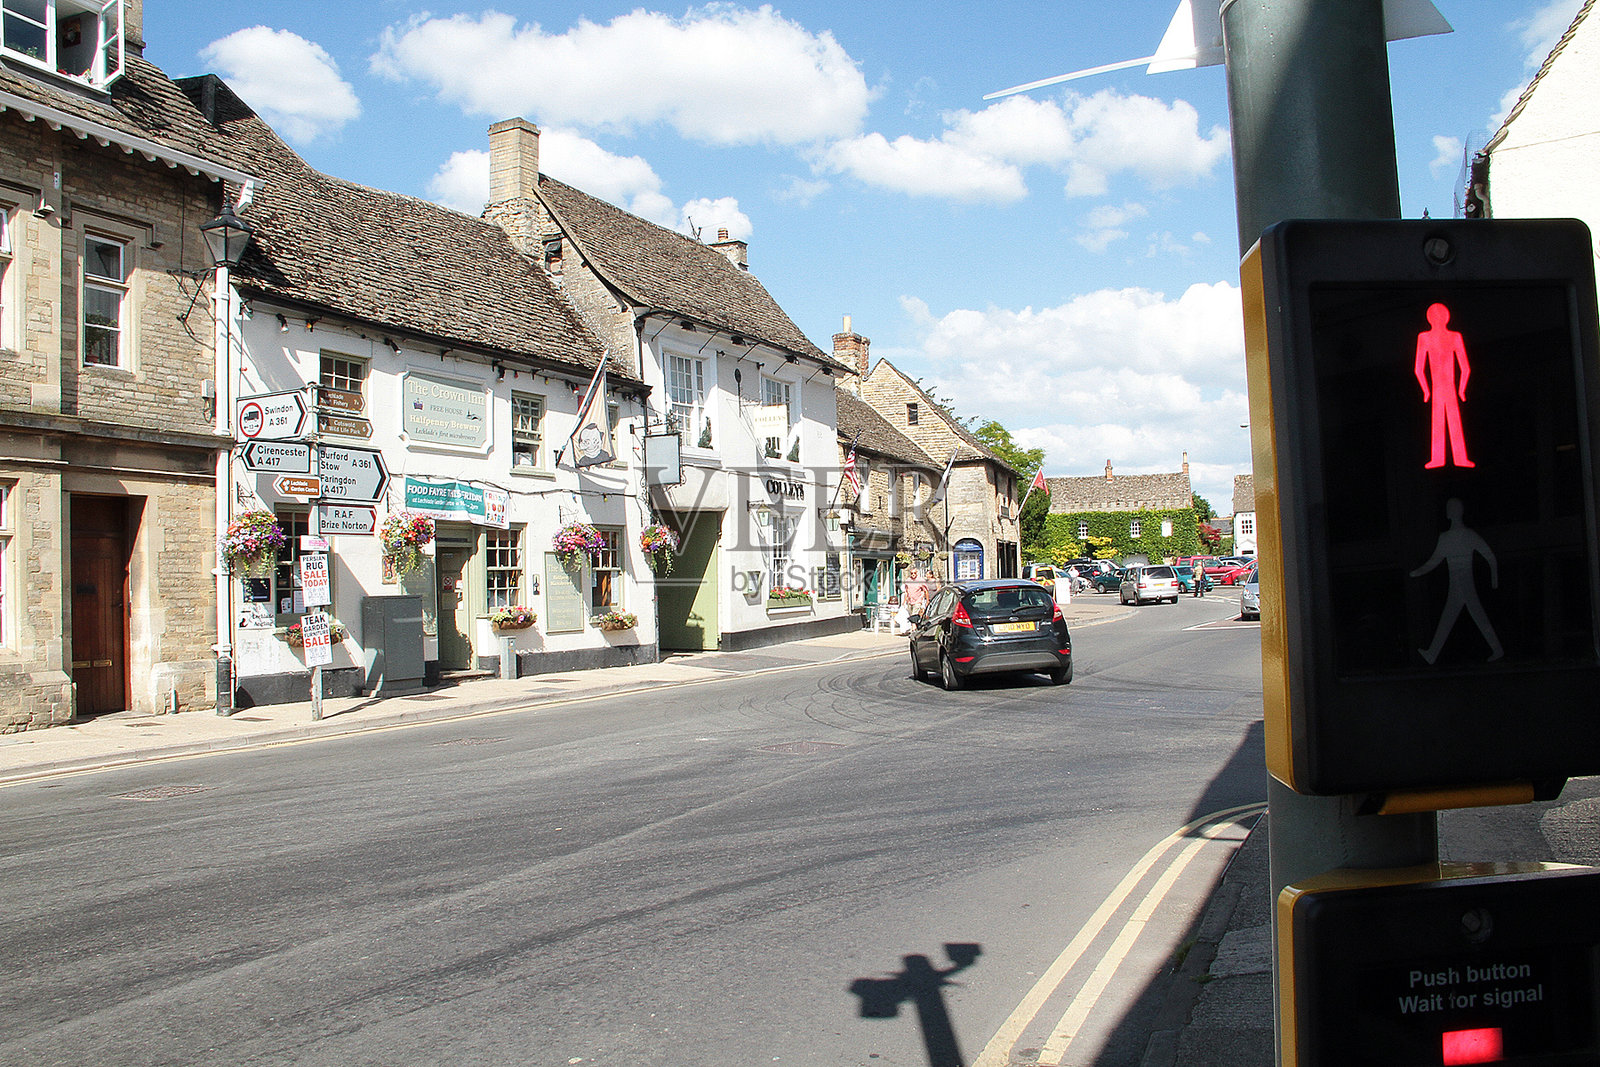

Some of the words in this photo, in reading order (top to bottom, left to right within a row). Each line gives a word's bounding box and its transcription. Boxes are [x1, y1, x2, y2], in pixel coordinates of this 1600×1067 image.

[408, 380, 428, 396] The
[432, 384, 466, 402] Crown
[468, 391, 485, 406] Inn
[264, 404, 294, 415] Swindon
[445, 407, 464, 415] HOUSE
[410, 415, 449, 428] Halfpenny
[451, 422, 481, 432] Brewery
[257, 445, 306, 456] Cirencester
[320, 450, 348, 460] Burford
[320, 461, 340, 470] Stow
[320, 474, 356, 484] Faringdon
[407, 485, 428, 496] FOOD
[429, 487, 446, 497] FAYRE
[322, 520, 340, 528] Brize
[342, 521, 368, 530] Norton
[306, 562, 324, 570] RUG
[304, 570, 327, 580] SALE
[304, 578, 328, 588] TODAY
[304, 614, 326, 625] TEAK
[304, 624, 328, 632] GARDEN
[304, 630, 328, 638] FURNITURE
[306, 635, 330, 648] SALE
[1409, 967, 1460, 988] Push
[1466, 963, 1531, 983] button
[1398, 993, 1444, 1014] Wait
[1448, 990, 1478, 1009] for
[1483, 984, 1544, 1009] signal
